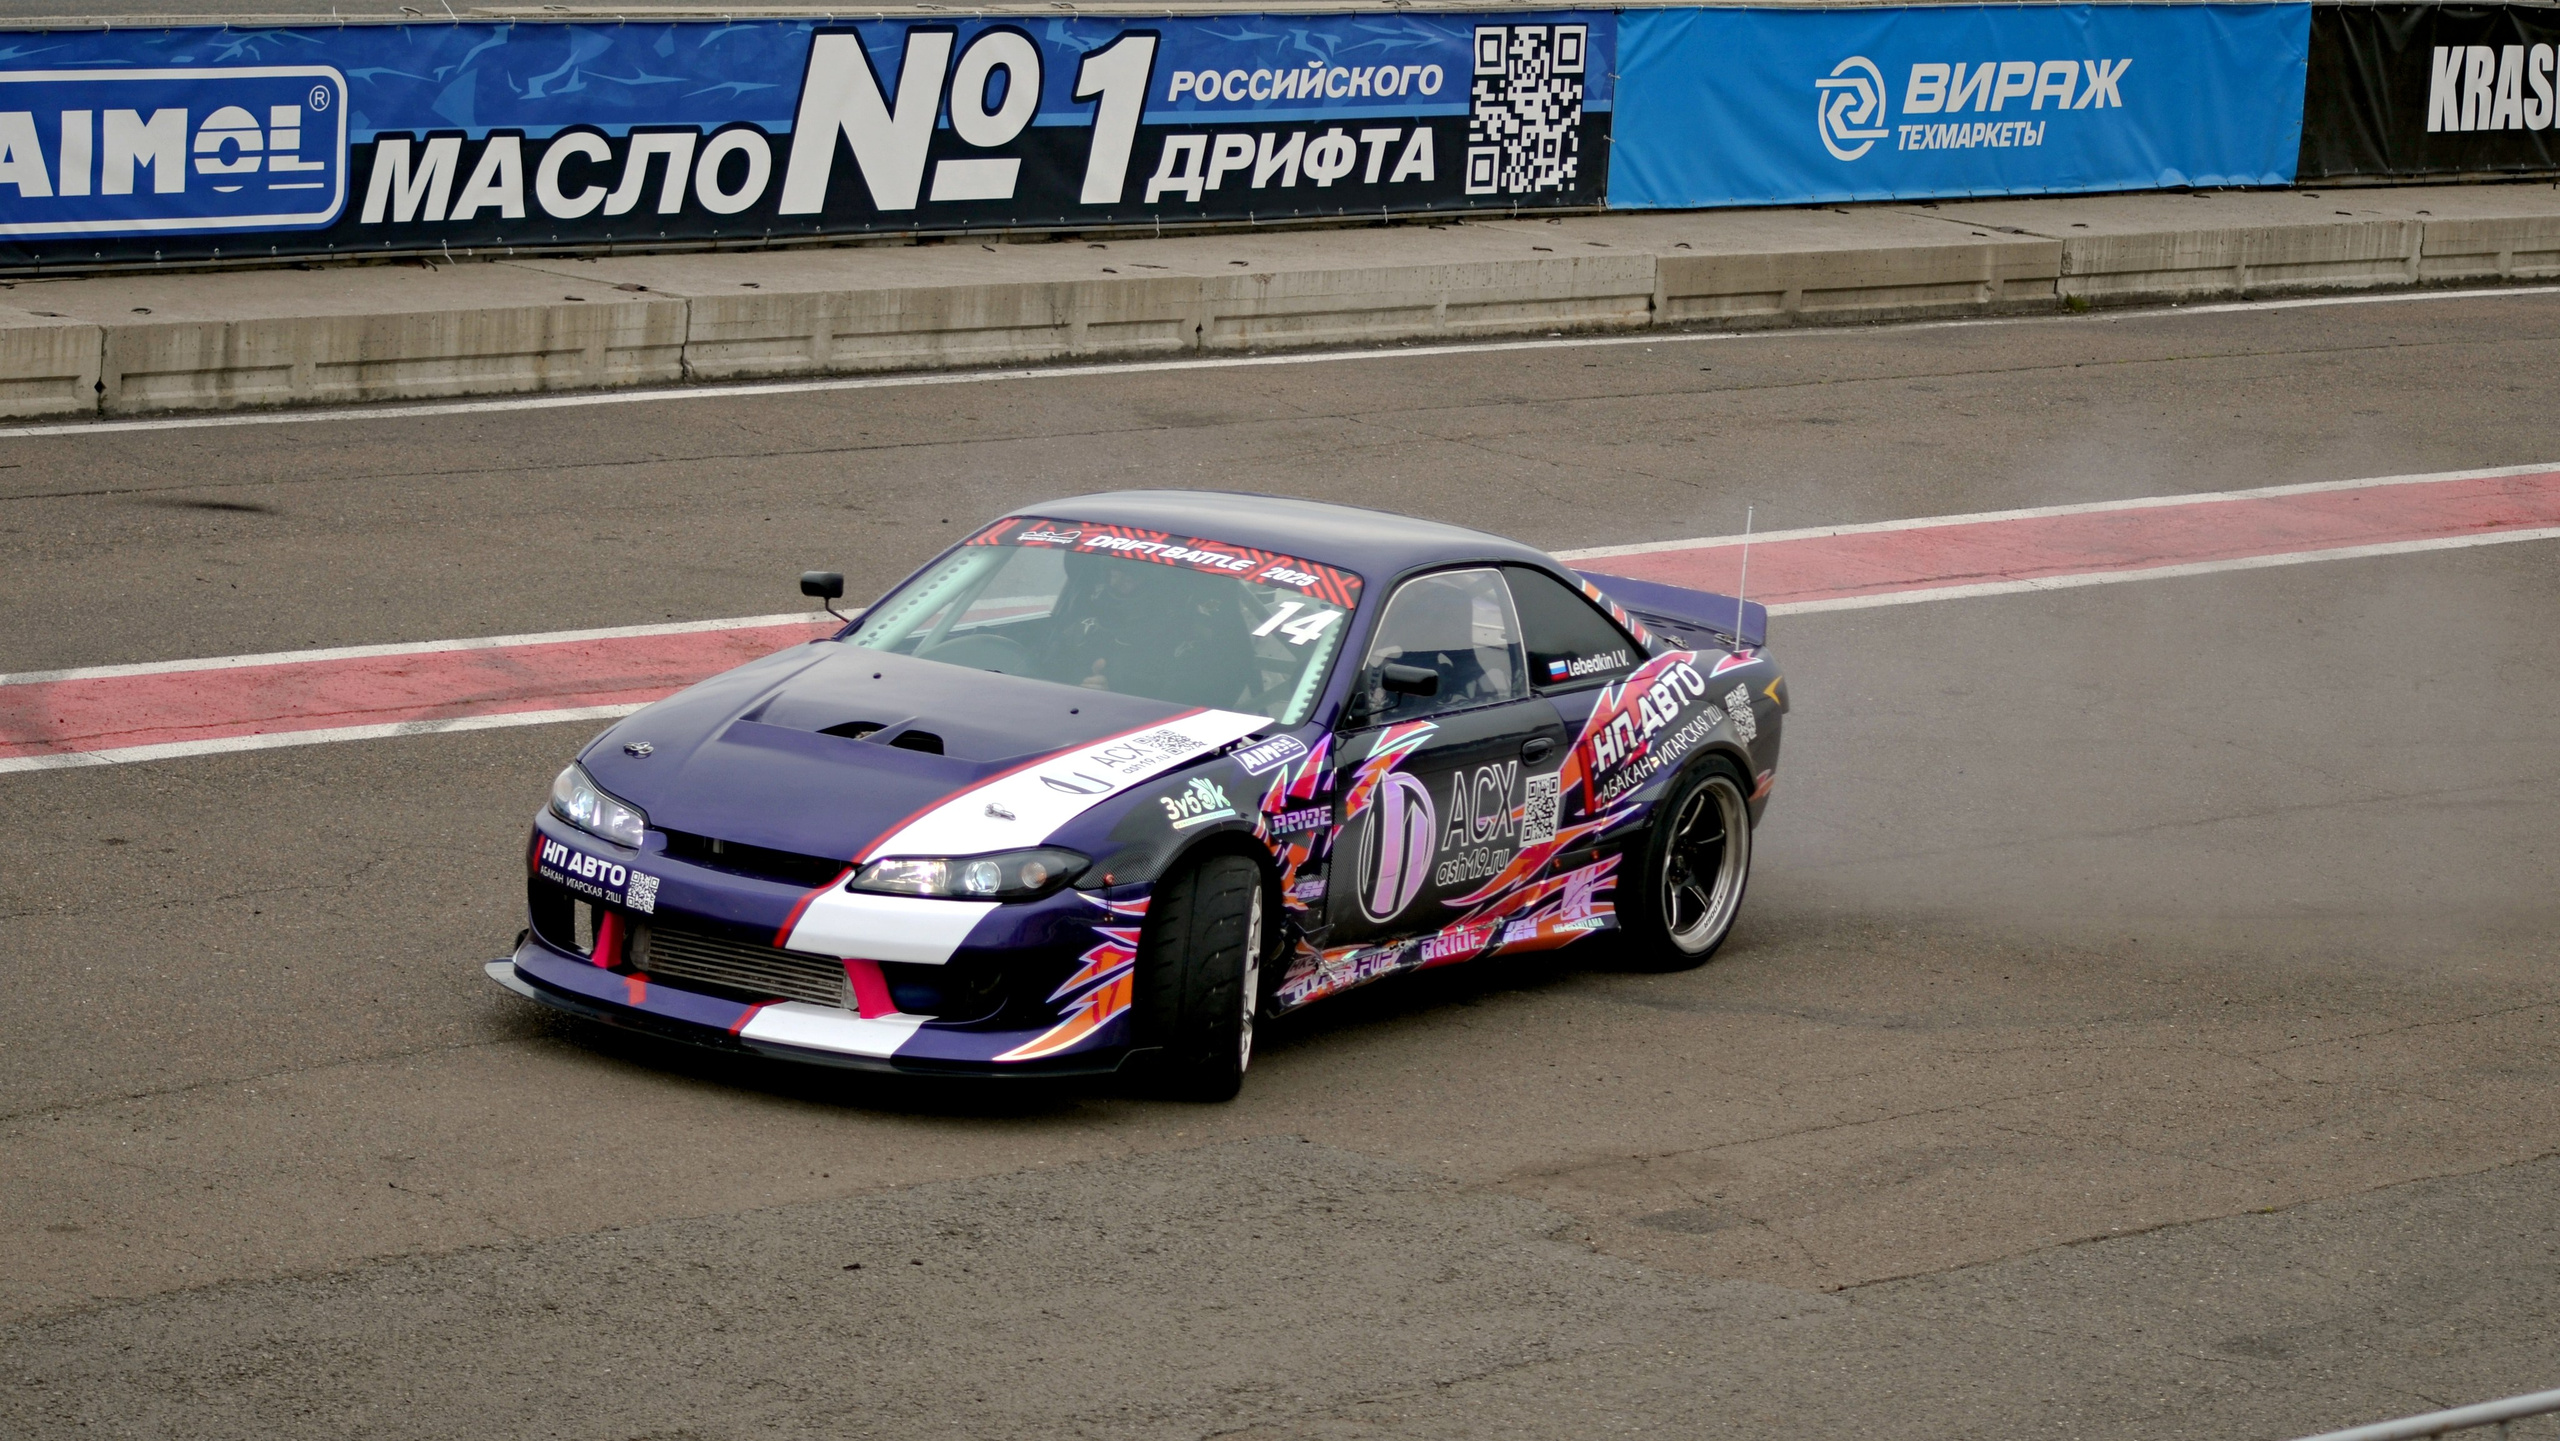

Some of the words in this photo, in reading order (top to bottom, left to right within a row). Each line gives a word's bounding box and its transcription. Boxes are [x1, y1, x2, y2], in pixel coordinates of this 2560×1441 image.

[1167, 60, 1444, 104] РОССИЙСКОГО
[1902, 57, 2133, 116] ВИРАЖ
[2427, 42, 2560, 132] KRAS
[1897, 120, 2046, 151] ТЕХМАРКЕТЫ
[360, 128, 772, 224] МАСЛО
[1143, 126, 1436, 204] ДРИФТА
[1084, 535, 1170, 554] DRIFT
[1158, 545, 1257, 571] BATTLE
[1260, 566, 1320, 587] 2025
[1252, 601, 1343, 646] 14
[1566, 652, 1615, 677] Lebedkin
[1612, 649, 1630, 668] I.V.
[1592, 710, 1638, 773] НП
[1638, 662, 1706, 740] АВТО
[1122, 753, 1171, 774] ash19.ru
[1602, 756, 1655, 803] АБАКАН
[1656, 715, 1712, 766] ИГАРСКАЯ
[540, 864, 564, 884] АБАКАН
[566, 875, 603, 898] ИГАРСКАЯ
[542, 839, 568, 868] НП
[567, 852, 627, 887] АВТО
[1436, 846, 1510, 887] ash19.ru
